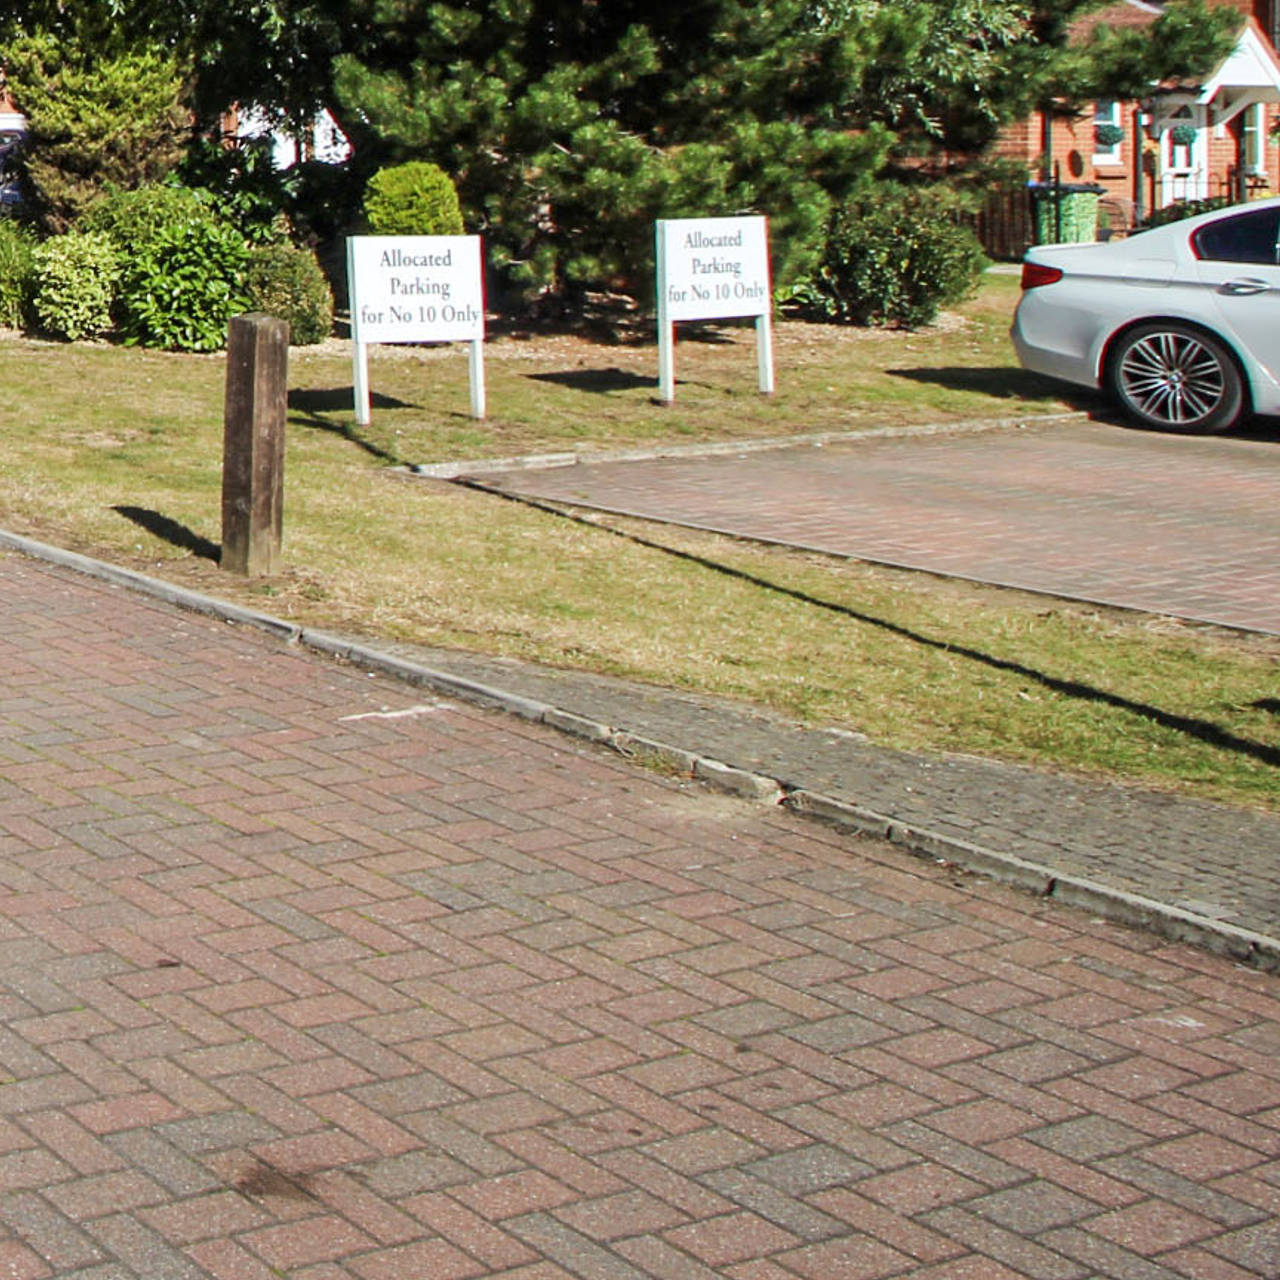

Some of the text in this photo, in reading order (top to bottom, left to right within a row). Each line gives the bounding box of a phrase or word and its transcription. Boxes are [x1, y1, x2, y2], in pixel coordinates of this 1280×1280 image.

[684, 230, 742, 248] Allocated
[380, 249, 452, 267] Allocated
[692, 257, 741, 278] Parking
[390, 277, 450, 301] Parking
[668, 280, 765, 302] for No 10 Only
[361, 304, 480, 327] for No 10 Only
